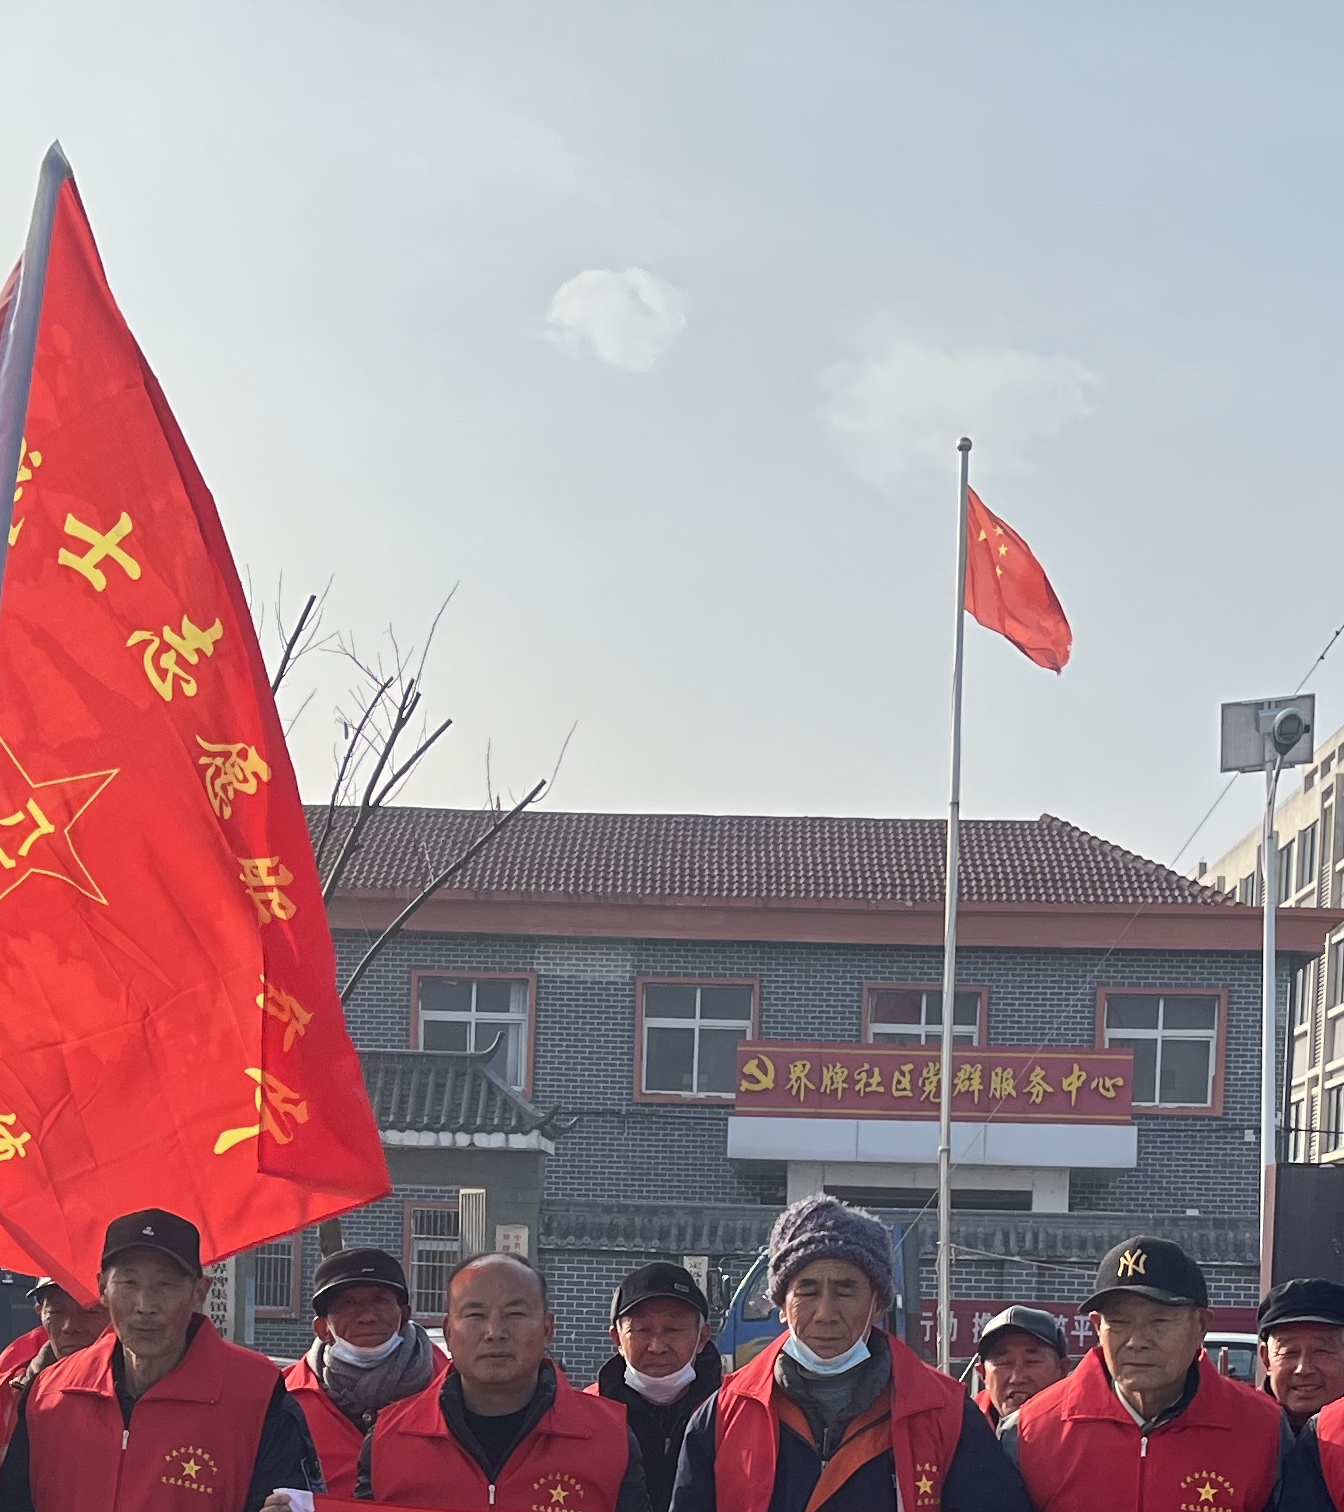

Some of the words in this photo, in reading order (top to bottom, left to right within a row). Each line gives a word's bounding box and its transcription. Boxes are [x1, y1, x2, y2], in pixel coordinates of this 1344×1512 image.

[8, 437, 313, 1154] 士志愿服务队
[785, 1060, 1124, 1107] 界牌社区党群服务中心
